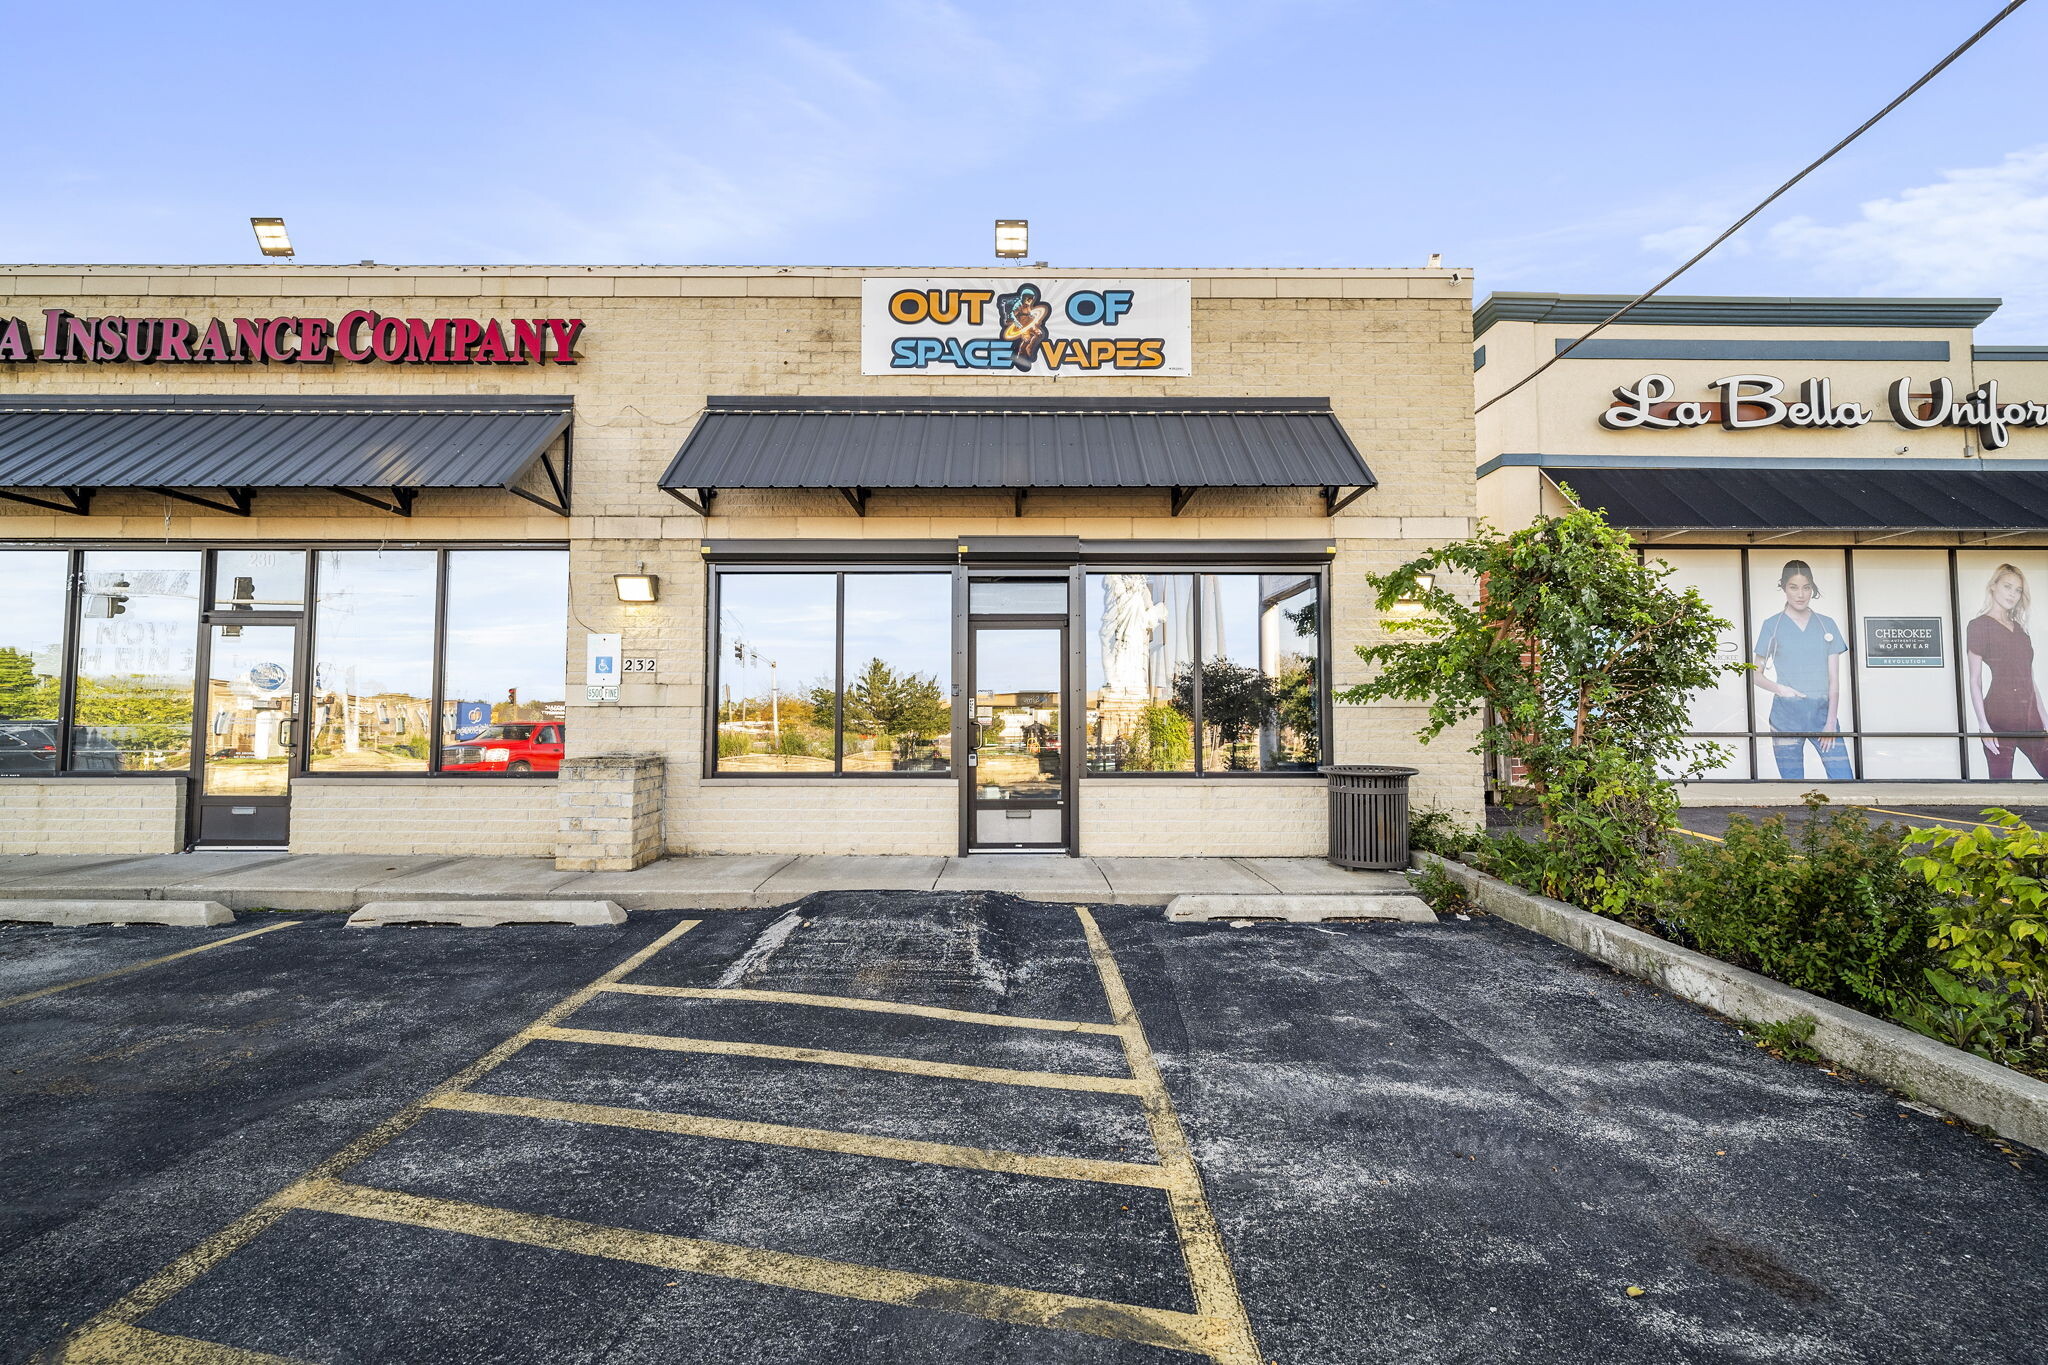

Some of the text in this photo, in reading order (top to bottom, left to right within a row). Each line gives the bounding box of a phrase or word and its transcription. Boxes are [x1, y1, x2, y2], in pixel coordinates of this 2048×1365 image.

[889, 289, 1134, 325] OUT OF
[39, 308, 335, 363] INSURANCE
[337, 310, 584, 364] COMPANY
[891, 338, 1164, 370] SPACE VAPES
[1600, 374, 2048, 451] La Bella Unifor
[1875, 628, 1932, 639] CHEROKEE
[624, 659, 656, 672] 232
[588, 688, 618, 698] $500 FINE
